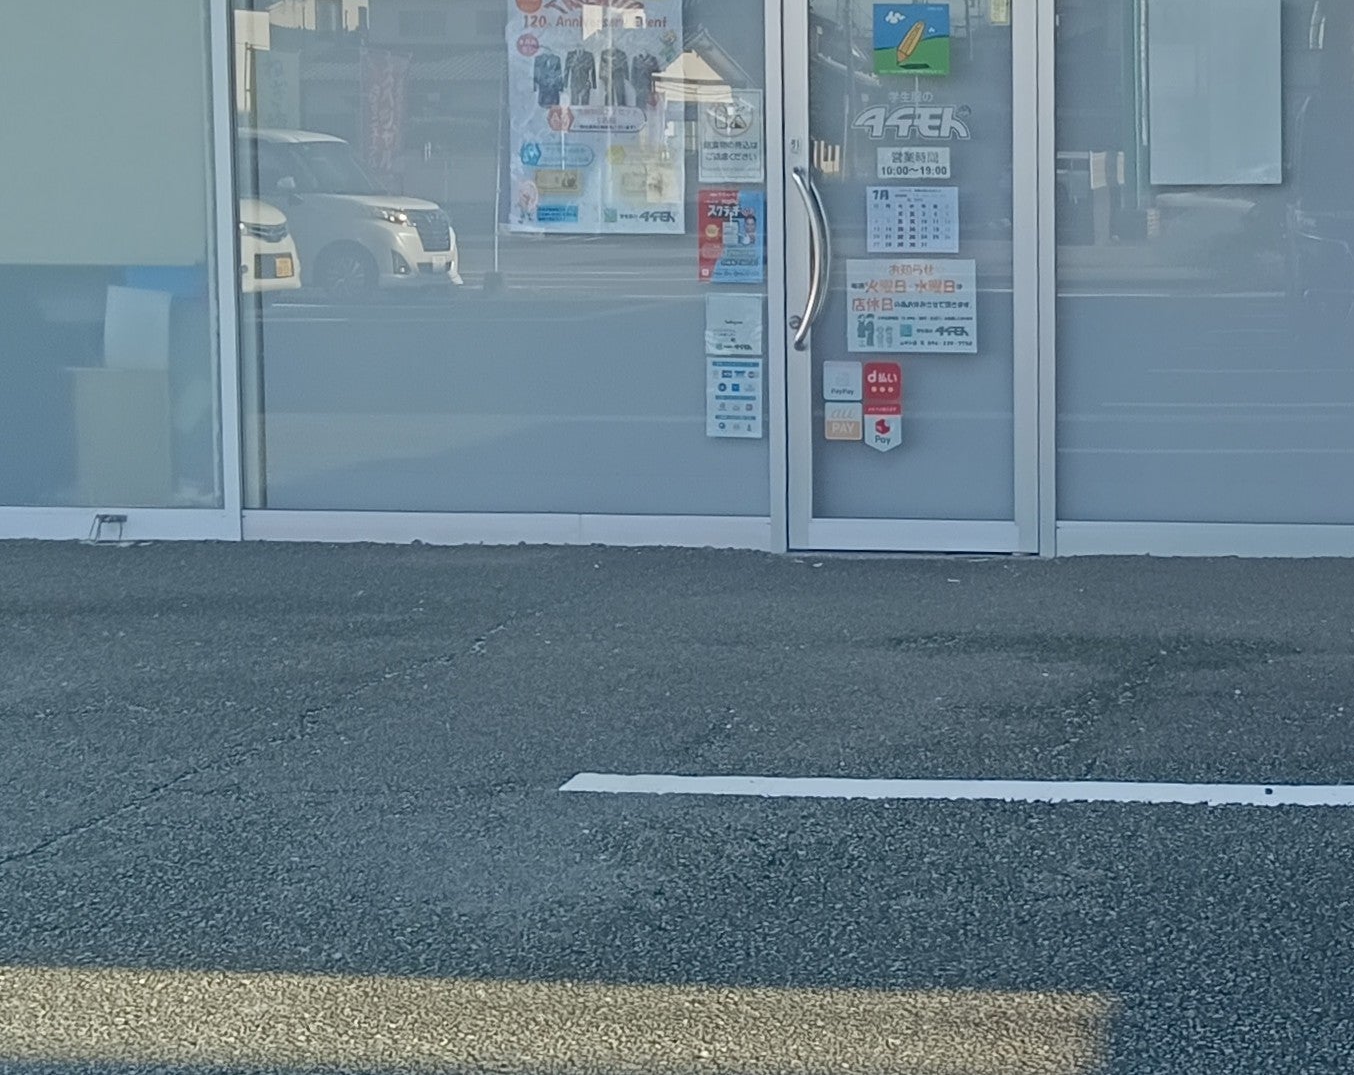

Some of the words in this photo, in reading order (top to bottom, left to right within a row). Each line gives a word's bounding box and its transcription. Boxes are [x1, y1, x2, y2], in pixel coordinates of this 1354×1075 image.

[524, 15, 547, 28] 120
[888, 264, 934, 276] お知らせ
[867, 370, 898, 384] d払い
[831, 388, 855, 396] PayPay
[832, 422, 855, 434] PAY
[874, 435, 891, 445] Pay
